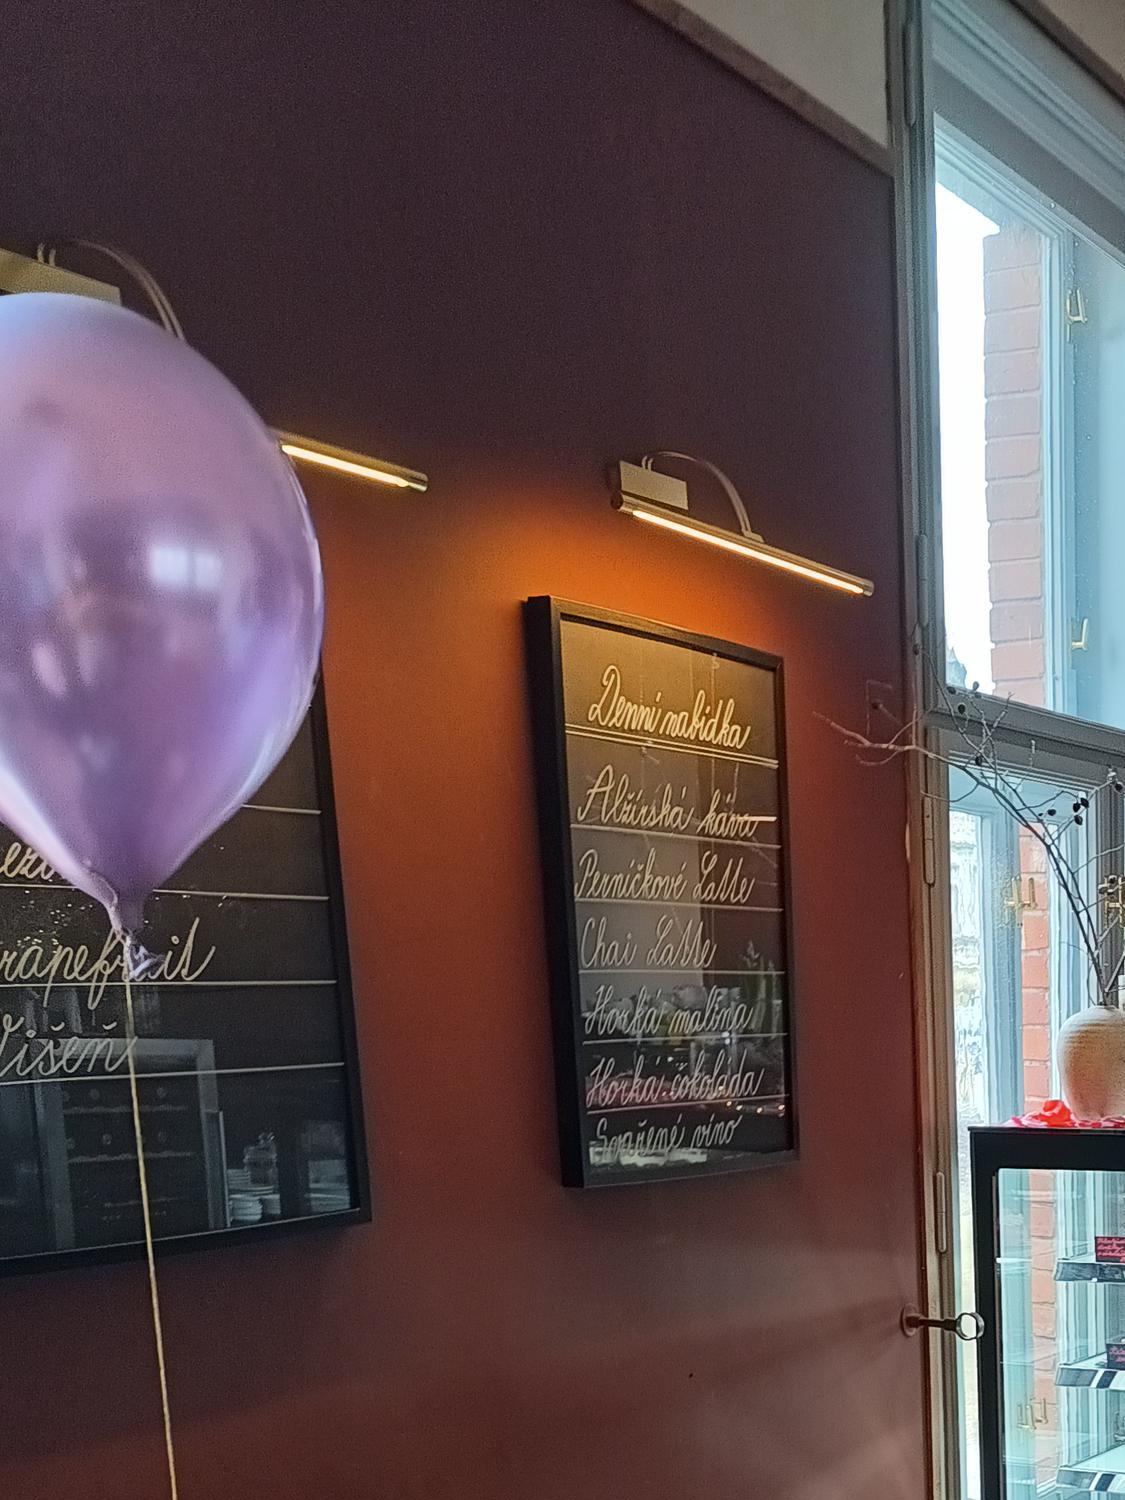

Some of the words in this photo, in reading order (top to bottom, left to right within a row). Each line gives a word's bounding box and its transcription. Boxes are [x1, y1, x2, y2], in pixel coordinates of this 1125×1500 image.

[588, 664, 662, 733] Denní
[577, 764, 694, 830] Alžírská
[697, 788, 759, 838] káva
[574, 848, 688, 900] Perníčkové
[692, 850, 756, 903] Latte
[581, 916, 637, 968] Chai
[646, 914, 718, 969] Latte
[584, 985, 665, 1035] Horká
[667, 985, 754, 1034] malina
[585, 1054, 666, 1108] Horká
[690, 1112, 743, 1151] víno
